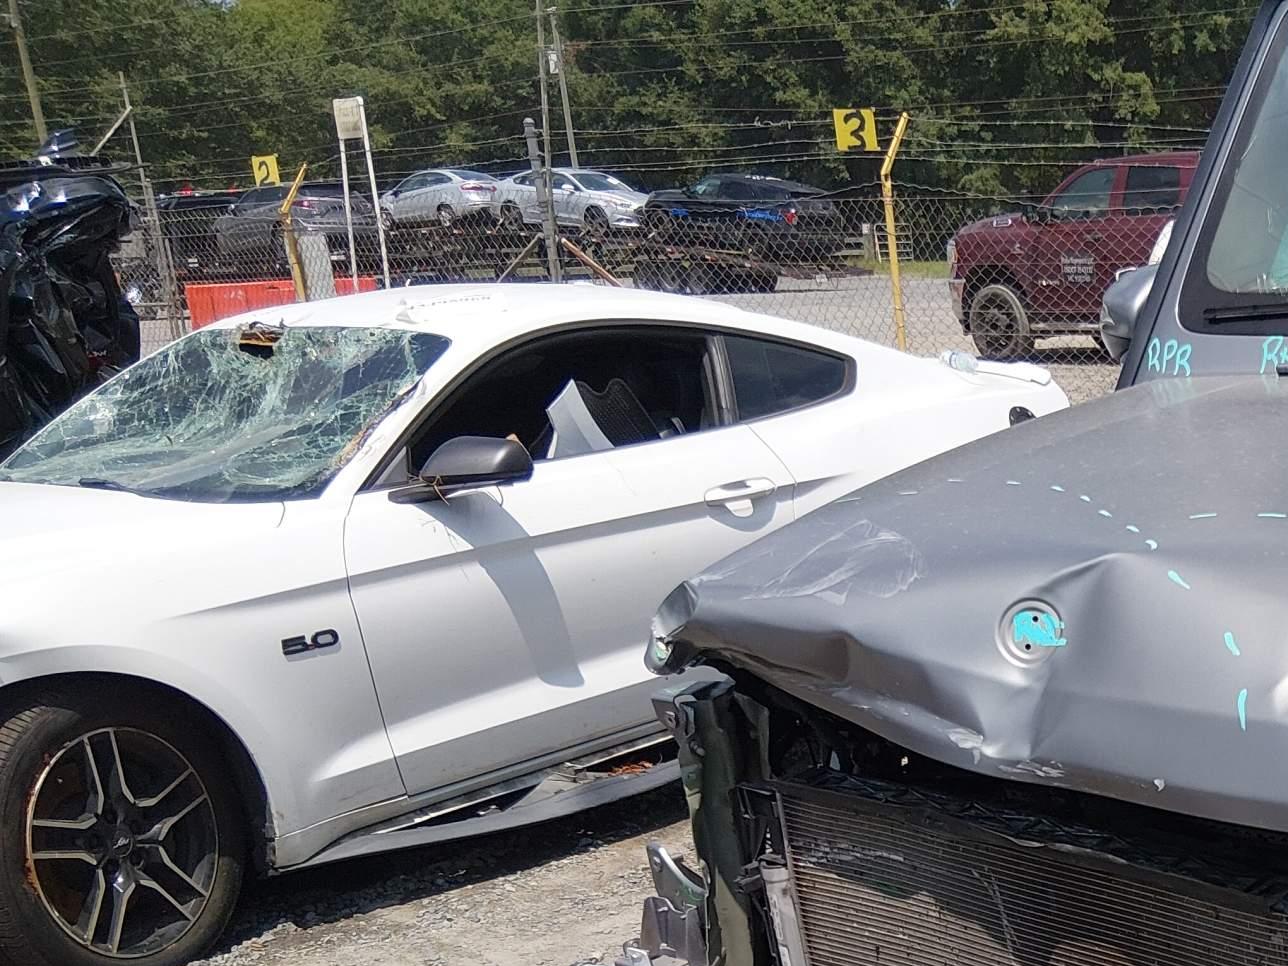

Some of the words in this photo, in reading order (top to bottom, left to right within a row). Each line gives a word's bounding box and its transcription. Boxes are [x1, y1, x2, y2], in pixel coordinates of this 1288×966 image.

[843, 110, 867, 152] 3
[258, 160, 276, 186] 2
[281, 628, 339, 656] 5.0
